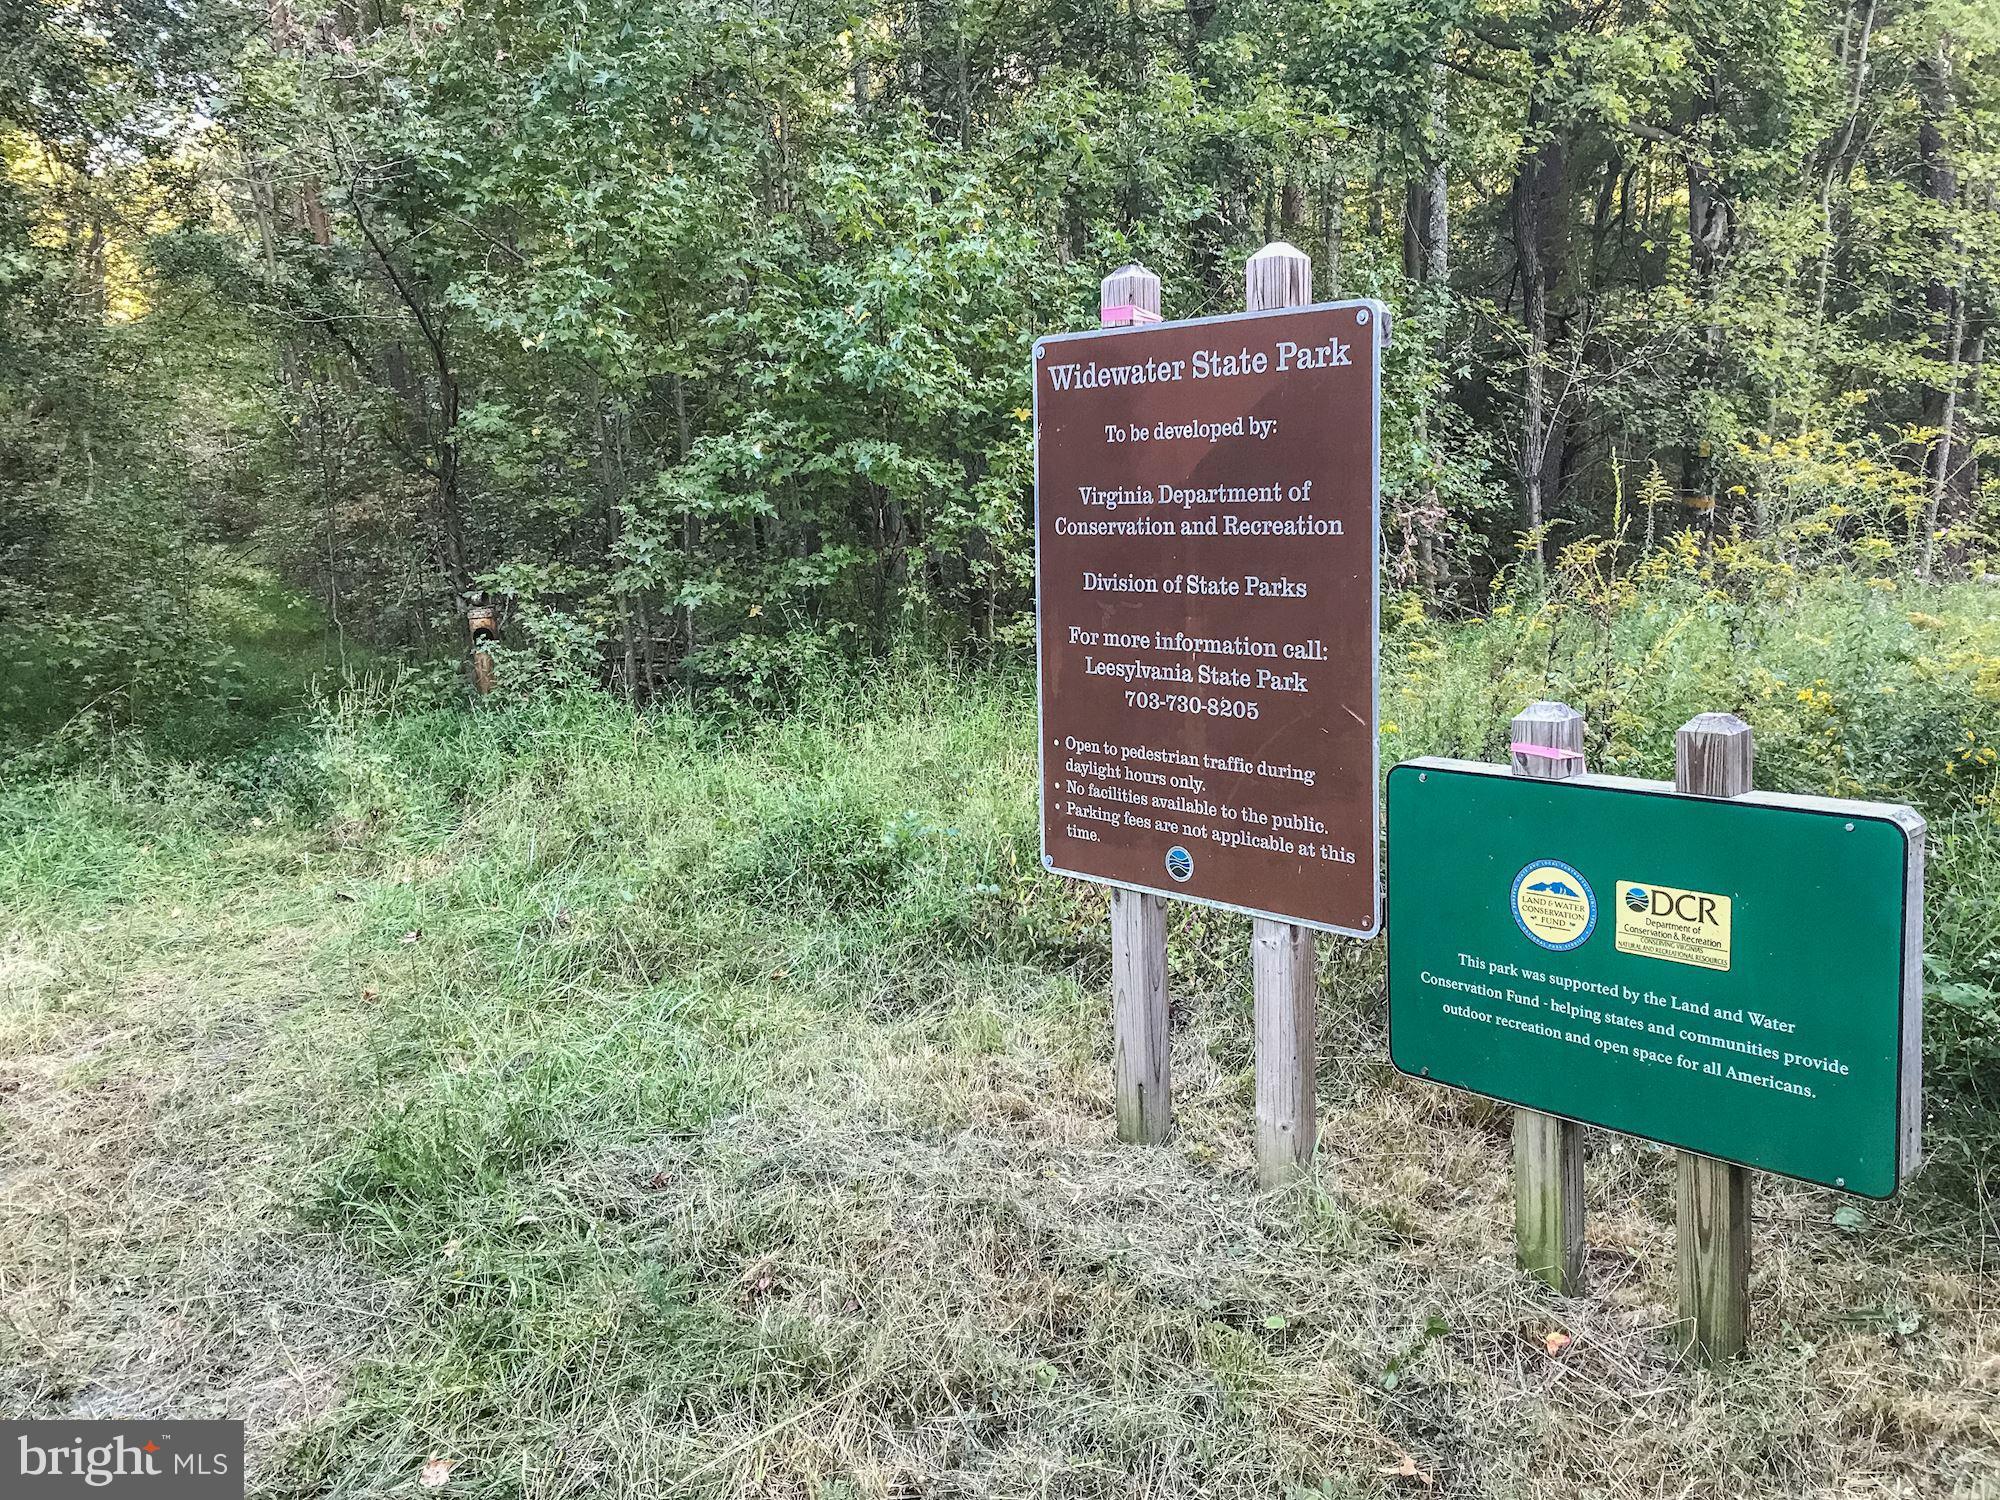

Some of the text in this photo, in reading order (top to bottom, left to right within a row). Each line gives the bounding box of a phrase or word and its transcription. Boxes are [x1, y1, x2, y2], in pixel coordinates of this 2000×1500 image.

[1048, 337, 1352, 390] Widewater State Park
[1105, 416, 1276, 442] To be developed by:
[1078, 480, 1312, 510] Virginia Department of
[1056, 515, 1344, 535] Conservation and Recreation
[1083, 572, 1306, 597] Division of State Parks
[1069, 626, 1328, 660] For more information call:
[1085, 656, 1308, 693] Leesylvania State Park
[1126, 691, 1258, 719] 703-730-8205
[1066, 736, 1315, 786] Open to pedestrian traffic during
[1066, 758, 1205, 794] daylight hours only.
[1066, 780, 1328, 834] No facilities available to the public.
[1066, 802, 1355, 864] Parking fees are not applicable at this
[1067, 824, 1100, 842] time.
[1521, 904, 1585, 921] CONSERVATION
[1522, 896, 1546, 906] LAND
[1555, 901, 1585, 912] WATER
[1652, 889, 1720, 926] DCR
[1541, 916, 1566, 927] FUND
[1624, 923, 1722, 948] Conservation & Recreation
[1645, 918, 1701, 934] Department of
[1618, 941, 1728, 966] NATURAL AND RECREATIONAL RESOURCES
[1640, 937, 1675, 949] CONSERVING
[1458, 954, 1795, 1033] This park was supported by the Land and Water
[1421, 972, 1502, 999] Conservation
[1506, 990, 1539, 1007] Fund
[1551, 999, 1601, 1024] helping
[1605, 1013, 1644, 1030] states
[1648, 1023, 1674, 1037] and
[1680, 1030, 1779, 1060] communities
[1784, 1053, 1848, 1075] provide
[1443, 1004, 1816, 1098] outdoor recreation and open space for all Americans.
